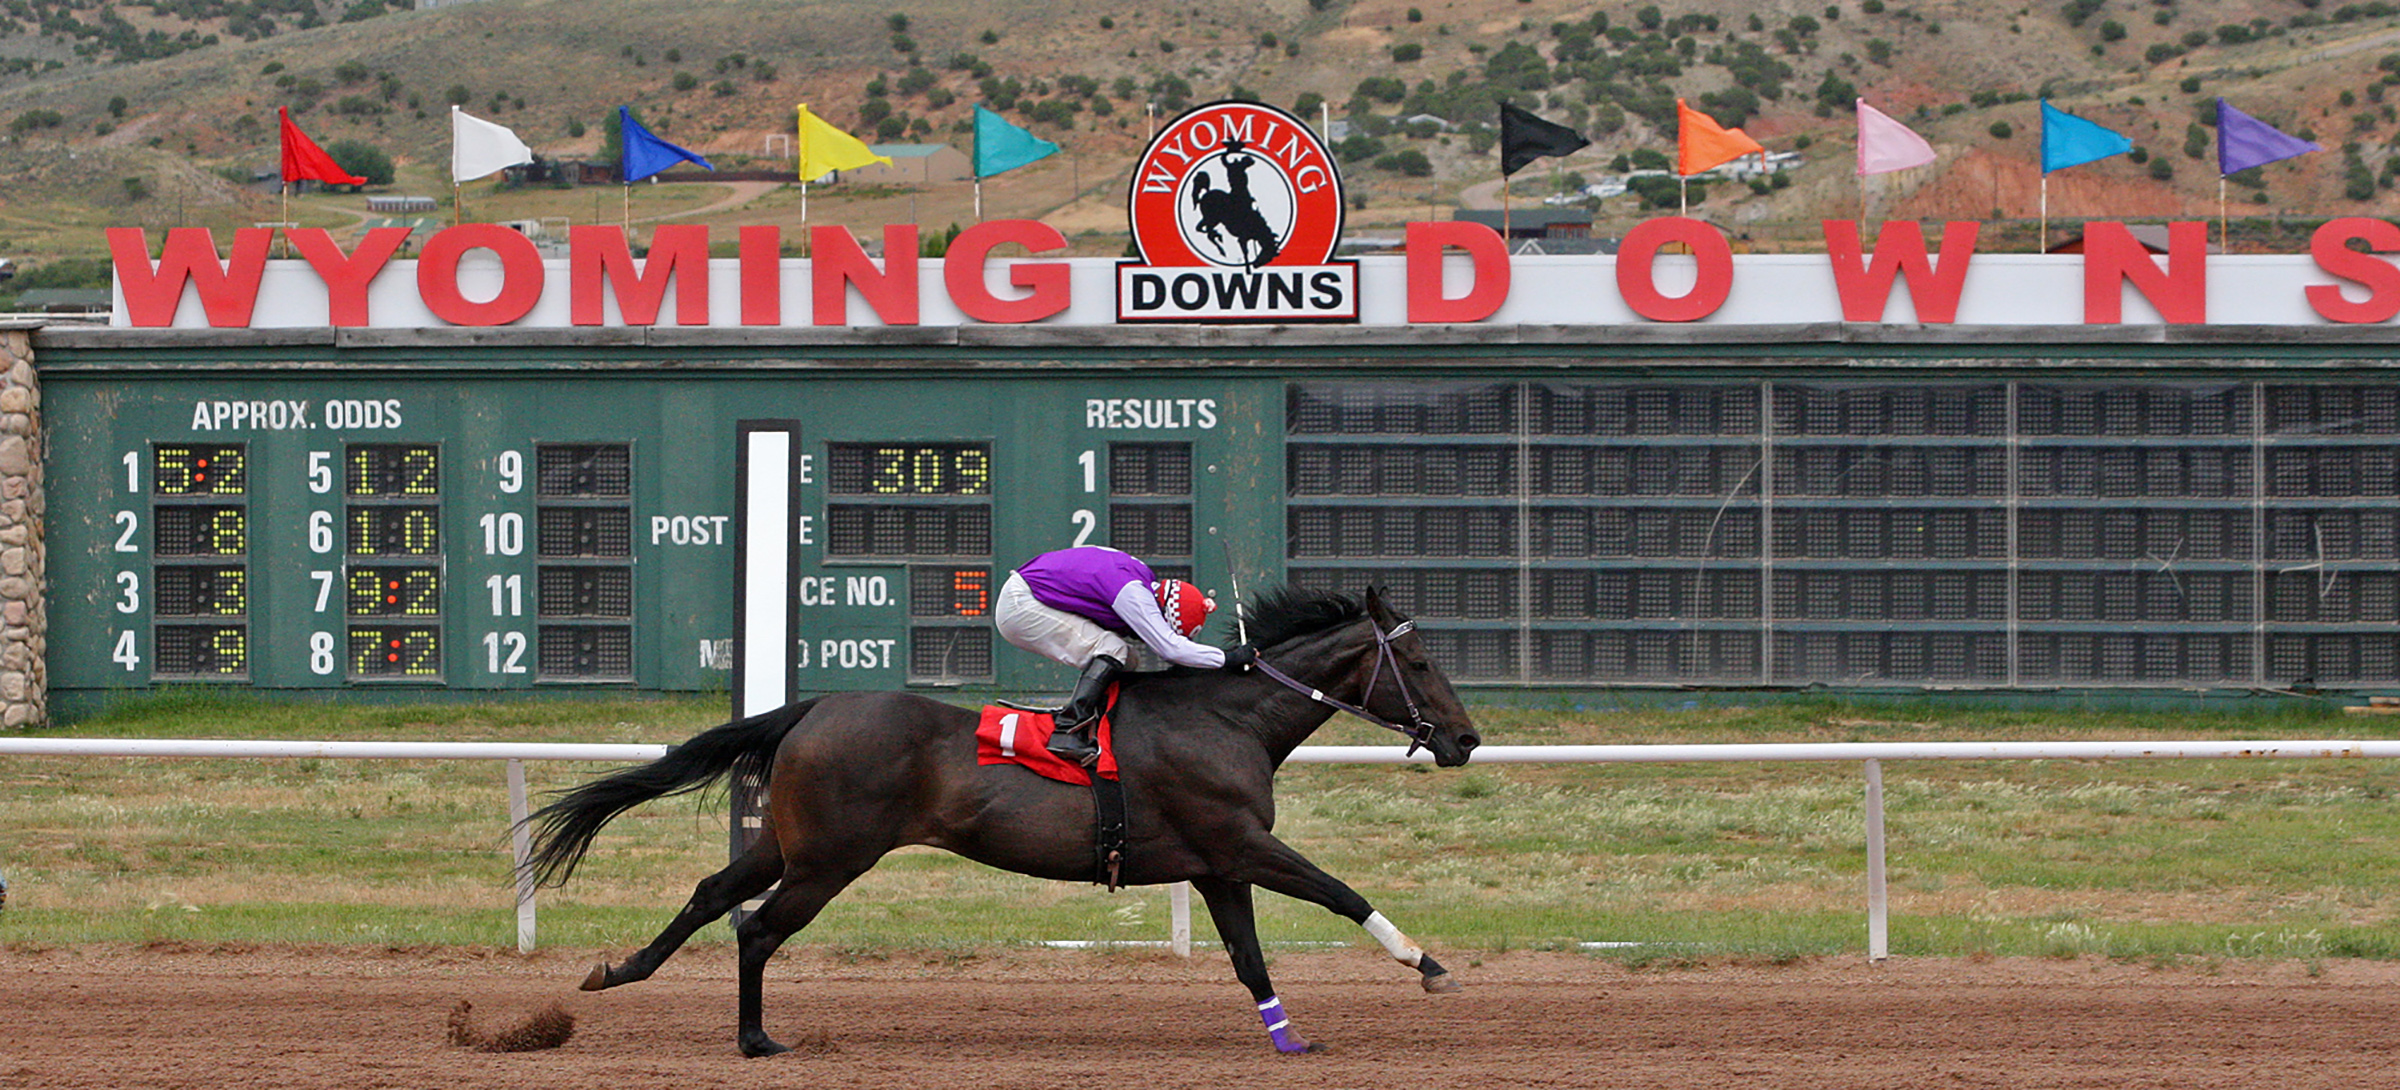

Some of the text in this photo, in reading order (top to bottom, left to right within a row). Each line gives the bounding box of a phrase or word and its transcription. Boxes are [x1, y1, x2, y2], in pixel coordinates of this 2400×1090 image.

[1142, 114, 1328, 195] WYOMING
[106, 216, 2400, 327] WYOMING DOWNS
[1131, 271, 1344, 311] DOWNS
[191, 398, 403, 431] APPROX. ODDS
[1085, 398, 1218, 430] RESULTS
[123, 451, 139, 493] 1
[158, 449, 244, 494] 5:2
[308, 451, 333, 494] 5
[499, 450, 523, 494] 9
[1078, 450, 1096, 493] 1
[114, 510, 139, 553] 2
[212, 510, 245, 554] 8
[309, 510, 333, 554] 6
[479, 512, 524, 556] 10
[651, 515, 729, 546] POST
[1072, 509, 1096, 546] 2
[116, 570, 139, 614] 3
[213, 570, 245, 615] 3
[310, 570, 334, 612] 7
[349, 570, 437, 615] 9:2
[486, 574, 522, 616] 11
[846, 576, 896, 606] NO.
[953, 570, 988, 616] 5
[112, 629, 140, 672] 4
[212, 629, 245, 674] 9
[309, 631, 334, 675] 8
[351, 630, 437, 676] 7:2
[483, 631, 528, 674] 12
[820, 639, 896, 669] POST
[999, 713, 1020, 757] 1
